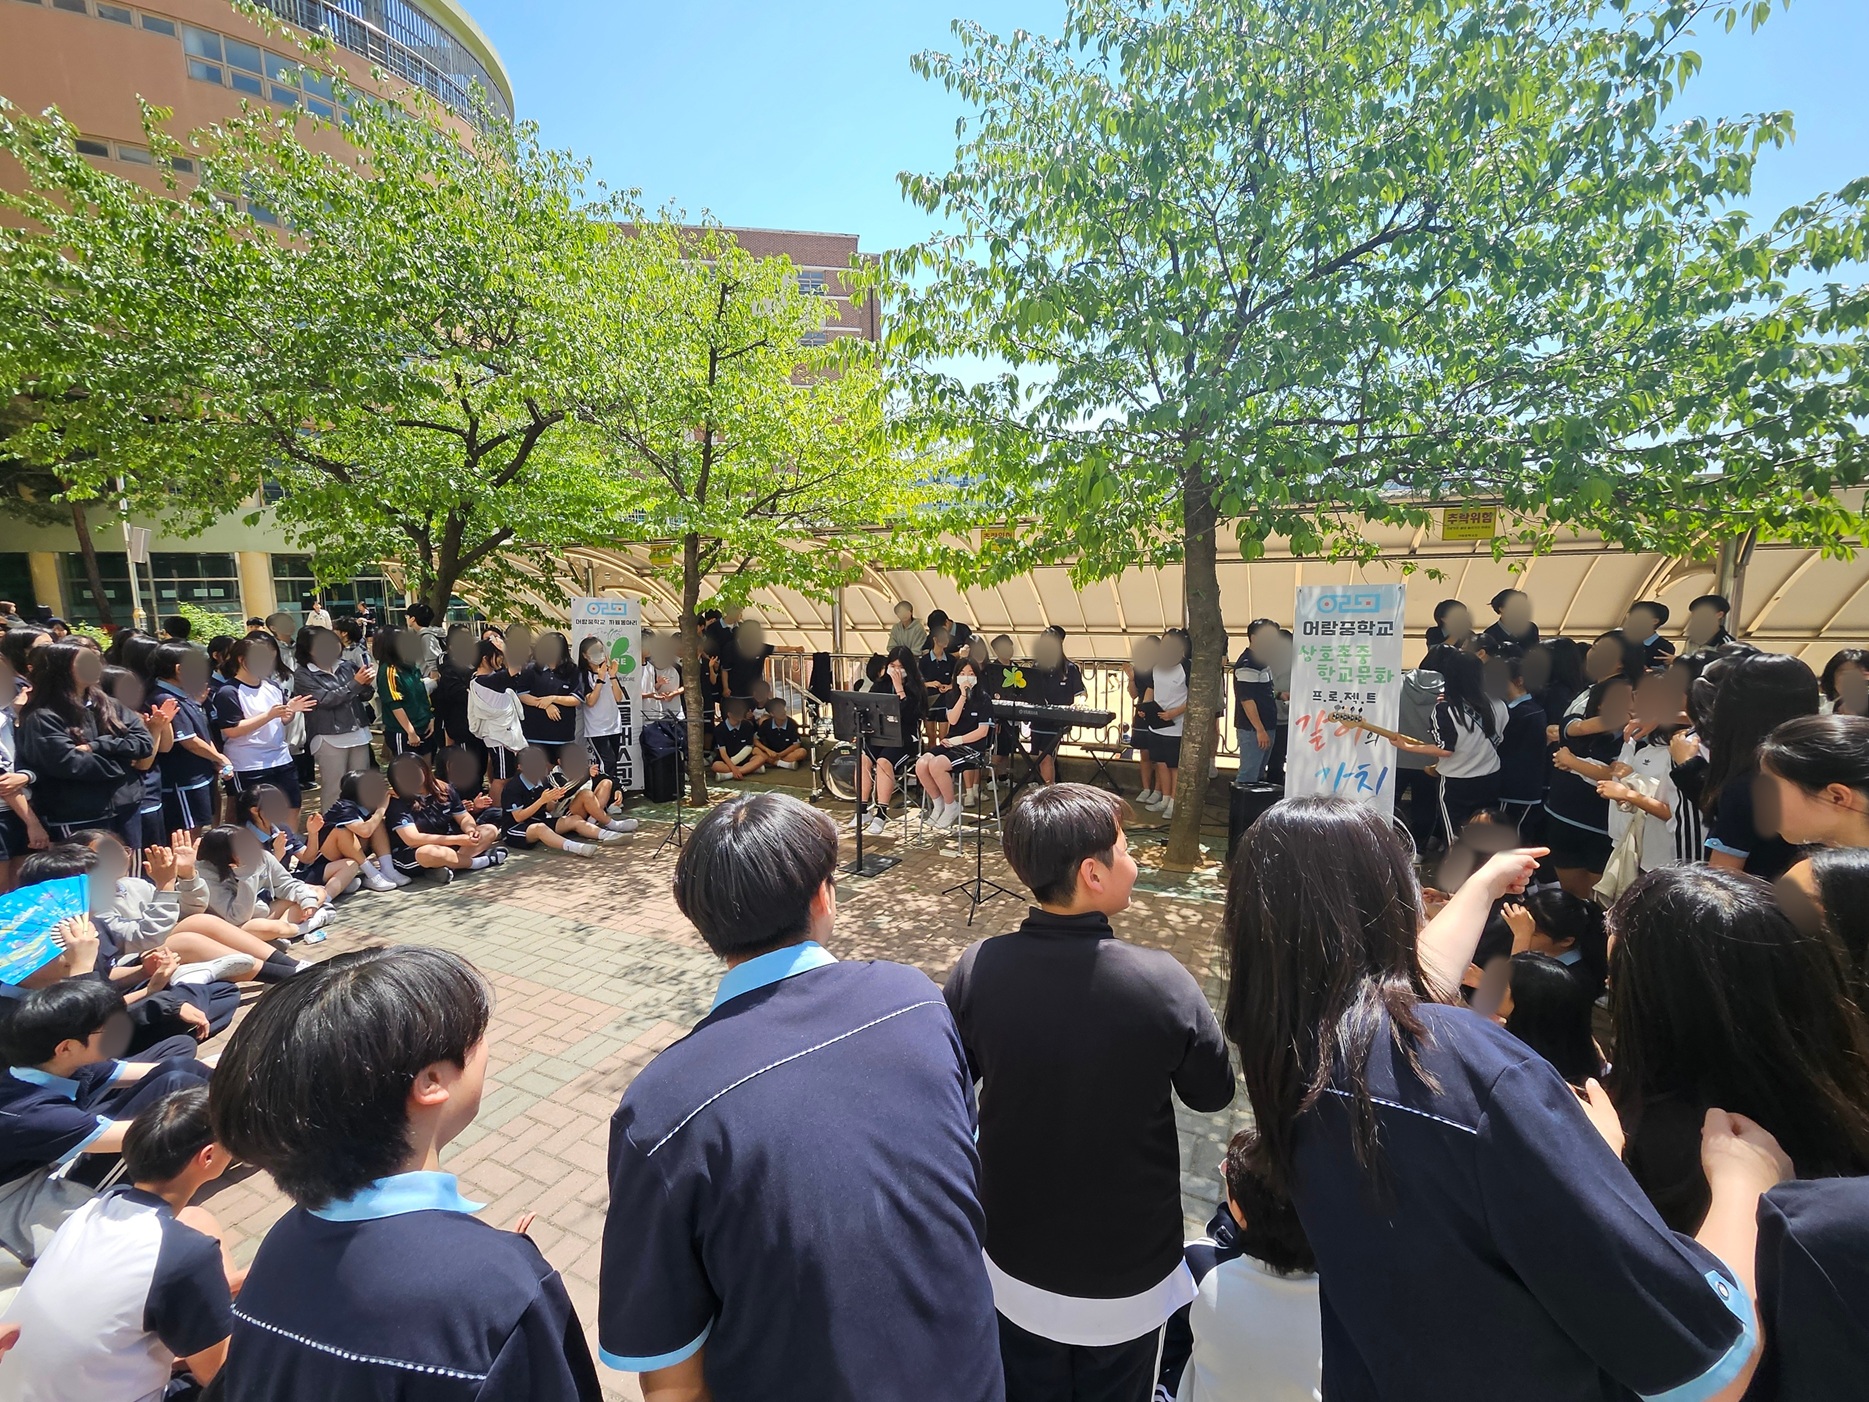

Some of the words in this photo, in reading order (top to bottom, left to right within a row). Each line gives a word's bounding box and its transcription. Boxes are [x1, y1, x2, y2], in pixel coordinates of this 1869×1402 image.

[1447, 512, 1493, 524] 추락위험
[1303, 620, 1394, 636] 어람중학교
[1299, 645, 1372, 664] 상호존중
[1316, 664, 1395, 685] 학교문화
[1314, 761, 1388, 796] 가치
